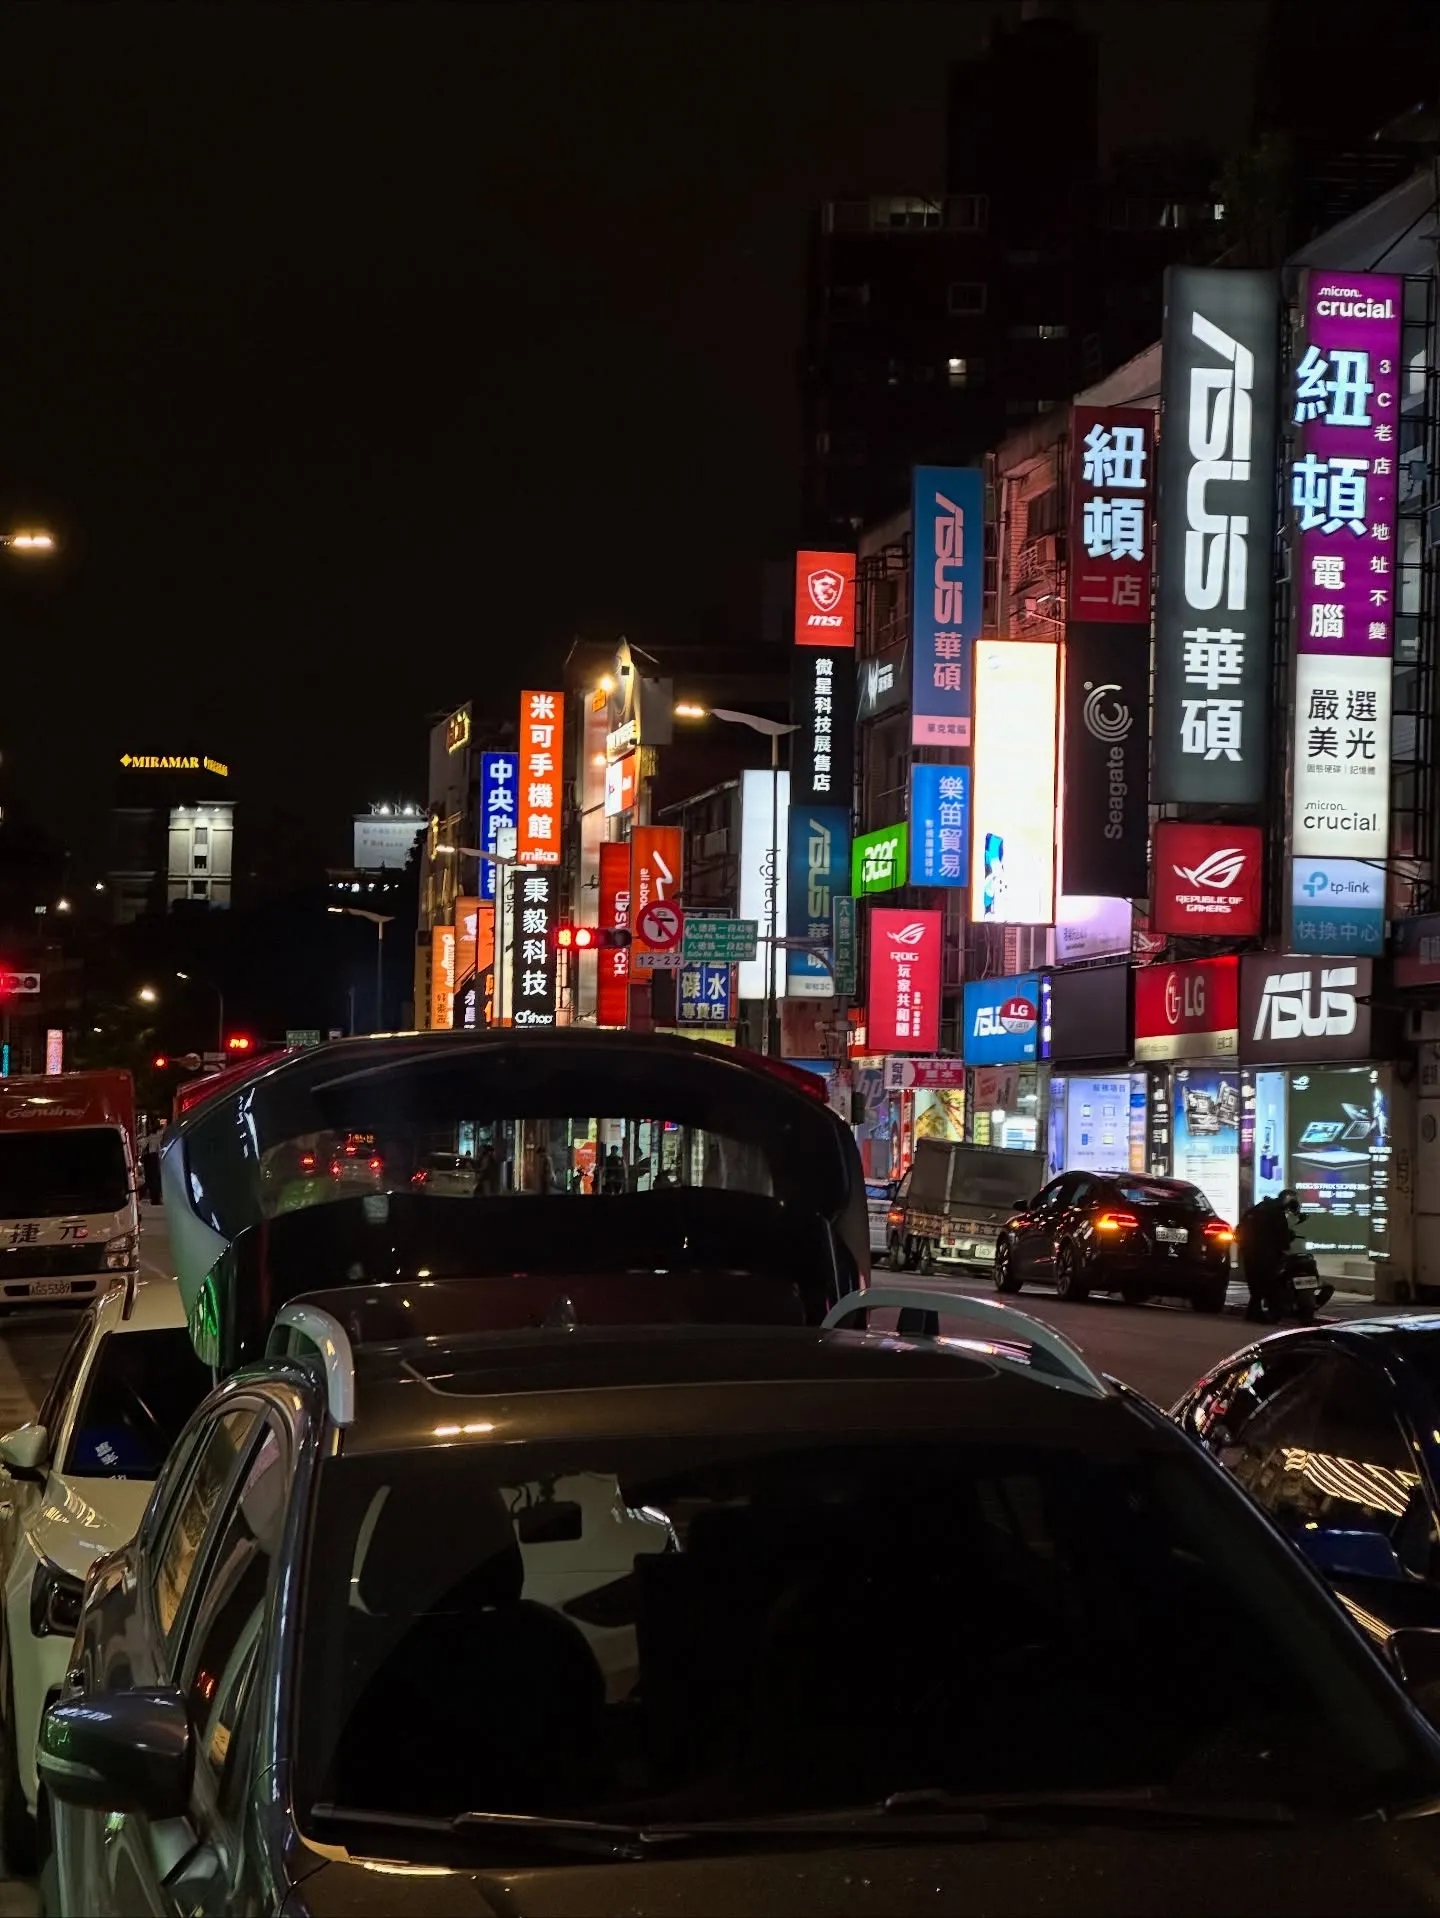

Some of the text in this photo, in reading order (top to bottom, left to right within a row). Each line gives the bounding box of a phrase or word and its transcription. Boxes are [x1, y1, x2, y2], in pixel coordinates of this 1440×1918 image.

[1317, 298, 1392, 318] crucial
[1185, 311, 1254, 611] ASUS
[1083, 424, 1147, 561] 紐頓
[1292, 345, 1374, 639] 紐頓 電腦
[934, 492, 964, 624] ASUS
[1080, 575, 1142, 607] 二店
[808, 614, 843, 627] msi
[933, 631, 964, 691] 華碩
[1180, 627, 1247, 762] 華碩
[1307, 689, 1377, 721] 嚴選
[812, 659, 833, 792] 微星科技展售店
[1307, 726, 1376, 759] 美光
[132, 756, 200, 769] MIRAMAR
[528, 694, 555, 839] 米可手機館
[1104, 746, 1128, 840] Seagate
[1304, 812, 1377, 831] crucial
[808, 818, 831, 919] ASUS
[1175, 895, 1244, 905] REPUBLIC OF
[1330, 881, 1369, 895] tp-link
[1186, 904, 1232, 914] GAMERS
[522, 878, 549, 997] 秉毅科技
[1297, 920, 1380, 942] 快換中心
[639, 956, 680, 966] 12-22
[891, 952, 919, 962] ROG
[1010, 1004, 1029, 1017] LG
[1184, 975, 1205, 1017] LG
[1253, 966, 1357, 1041] ASUS
[9, 1220, 89, 1245] 捷元
